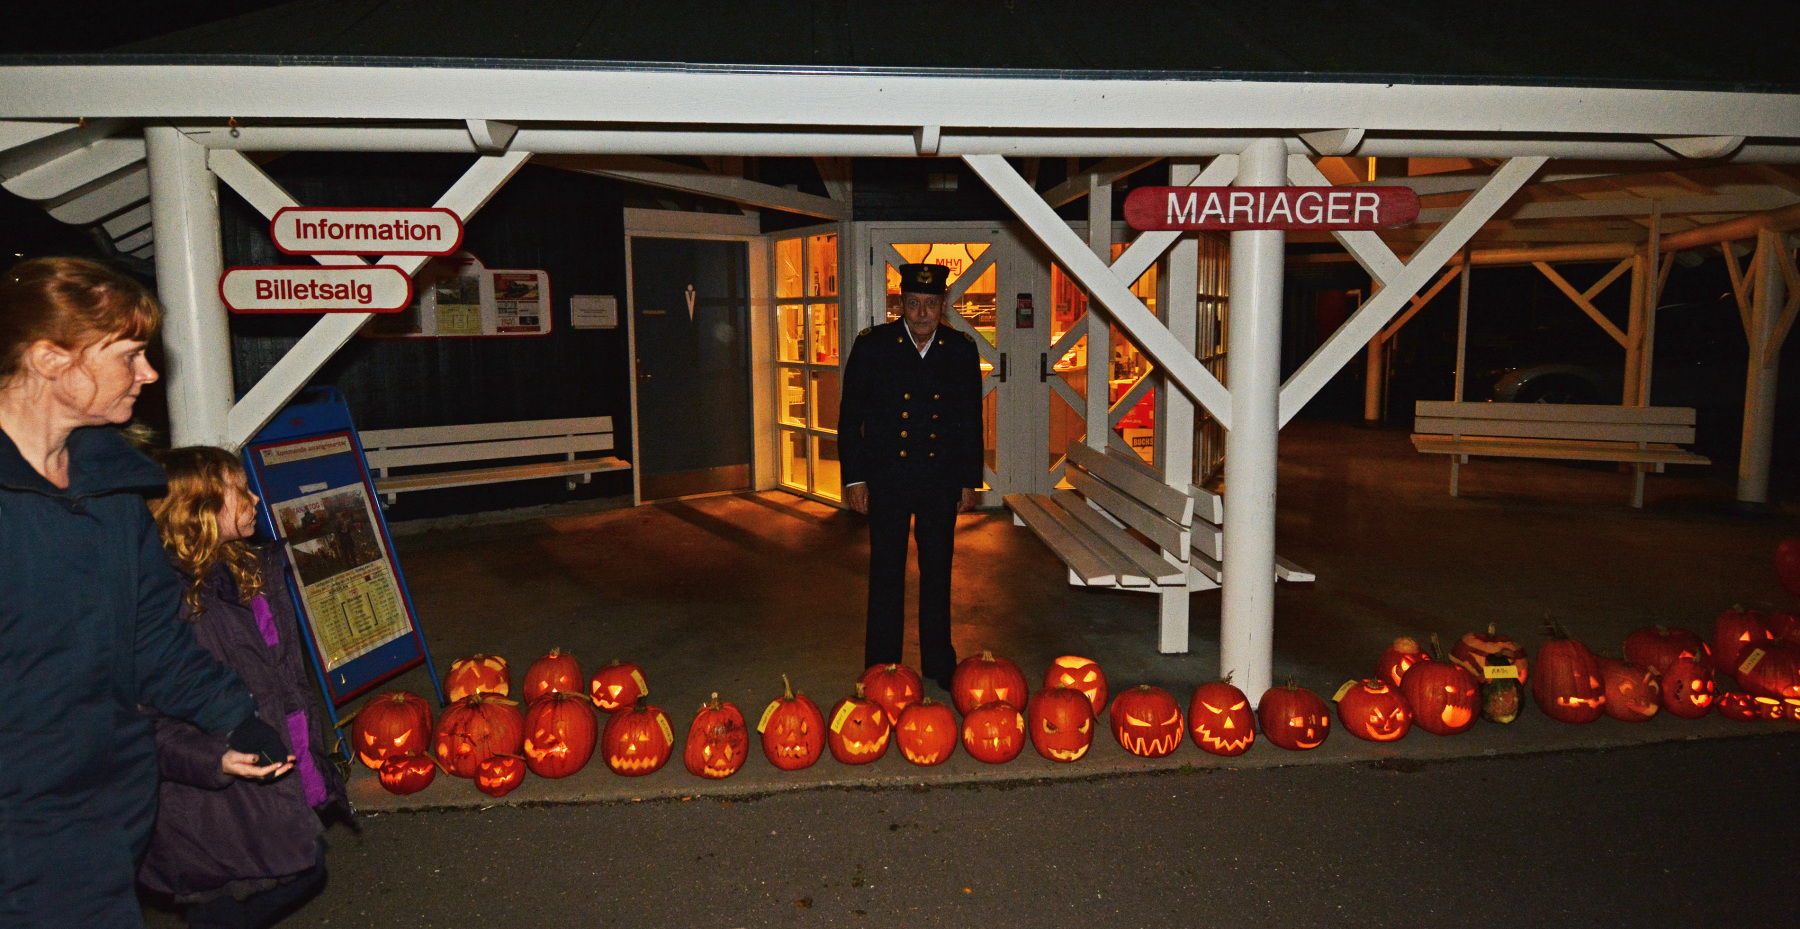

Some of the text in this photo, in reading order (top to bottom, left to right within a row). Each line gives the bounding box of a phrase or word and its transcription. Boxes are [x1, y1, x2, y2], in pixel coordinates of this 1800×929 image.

[1166, 191, 1380, 225] MARIAGER
[295, 218, 442, 242] Information
[254, 279, 373, 305] Billetsalg
